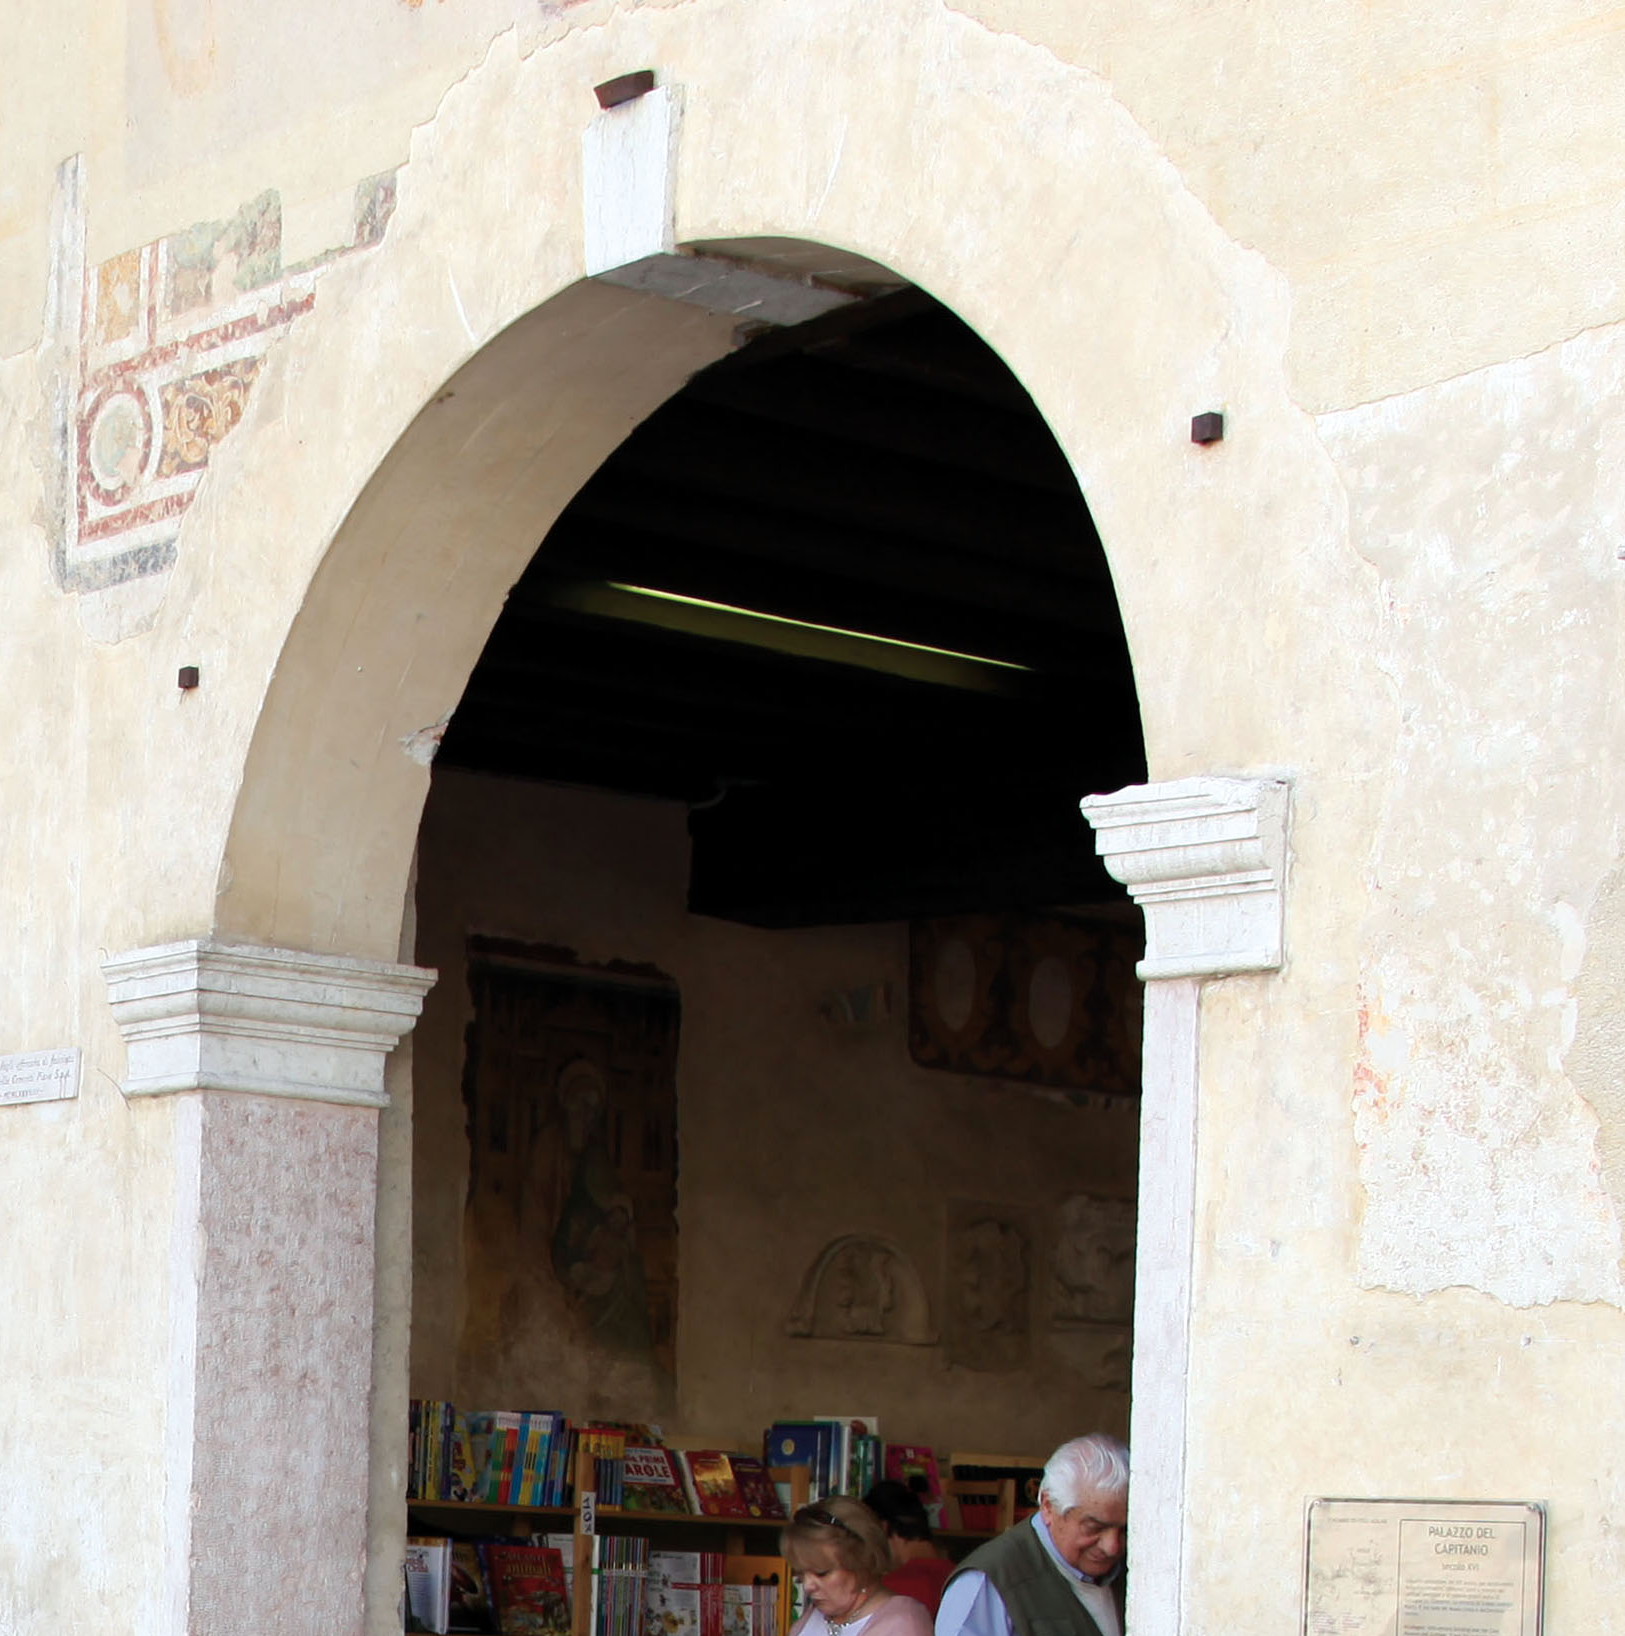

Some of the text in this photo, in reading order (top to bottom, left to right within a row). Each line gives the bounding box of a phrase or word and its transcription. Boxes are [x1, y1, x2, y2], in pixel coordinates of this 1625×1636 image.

[1428, 1526, 1496, 1539] PALAZZO DEL
[1434, 1543, 1489, 1556] CAPITANIO
